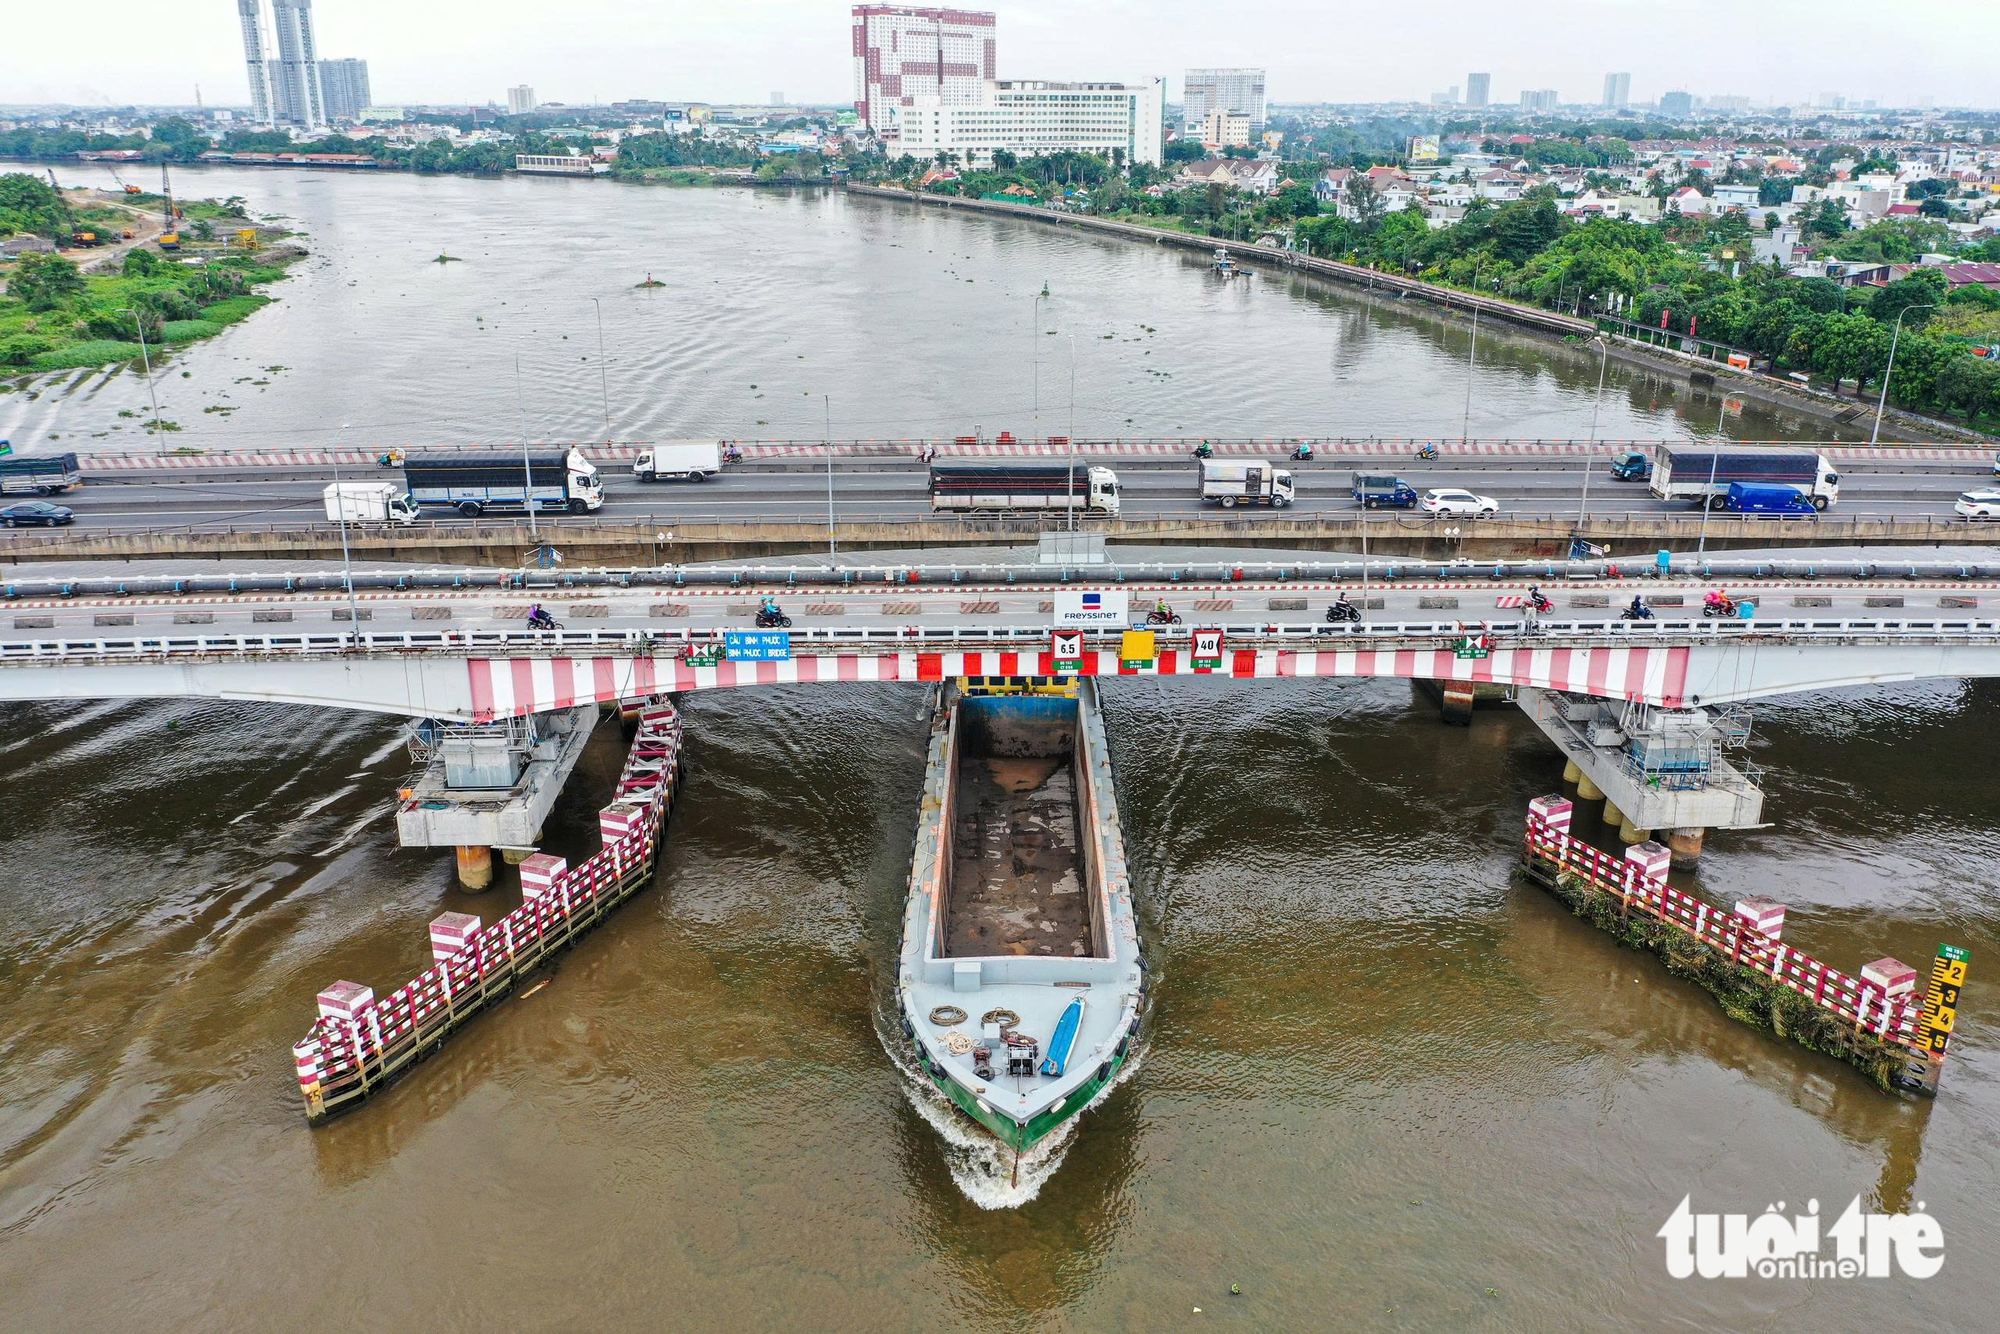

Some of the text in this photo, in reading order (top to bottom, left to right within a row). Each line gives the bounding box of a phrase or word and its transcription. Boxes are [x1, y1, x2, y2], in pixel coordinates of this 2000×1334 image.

[1061, 644, 1075, 654] 6.5
[1201, 640, 1214, 650] 40
[728, 649, 741, 657] BINH
[744, 649, 761, 657] PHUOC
[768, 649, 787, 657] BRIDGE
[1951, 967, 1961, 980] 2
[1946, 990, 1956, 1003] 3
[1941, 1013, 1949, 1026] 4
[1934, 1035, 1944, 1048] 5
